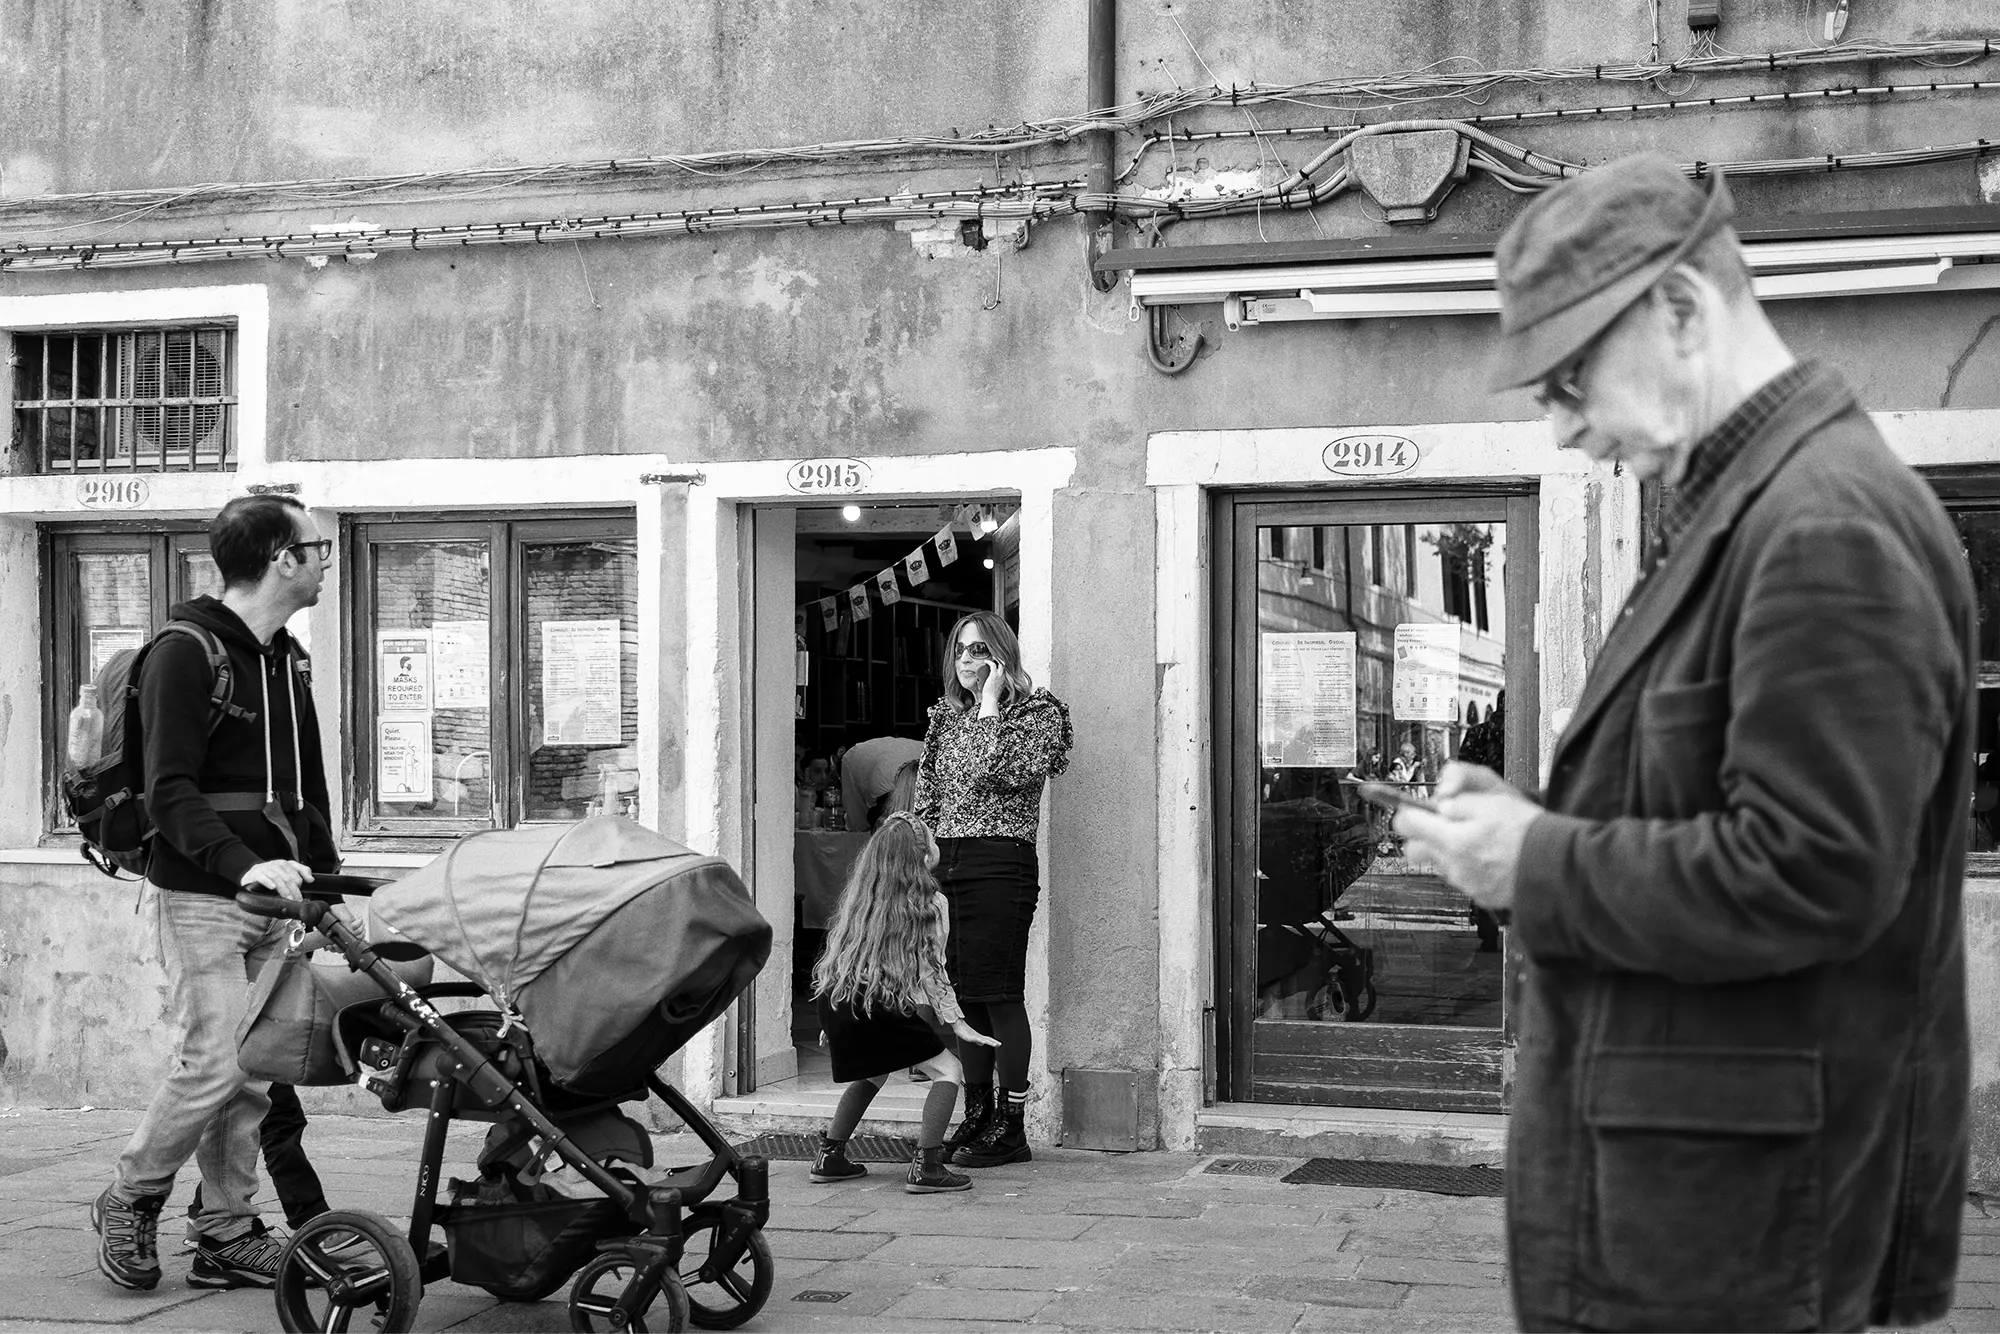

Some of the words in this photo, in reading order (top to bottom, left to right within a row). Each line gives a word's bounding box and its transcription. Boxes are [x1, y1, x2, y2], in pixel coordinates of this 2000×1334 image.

[1333, 441, 1407, 468] 2914
[798, 464, 861, 488] 2915
[85, 481, 140, 503] 2916
[420, 1164, 430, 1196] NICO
